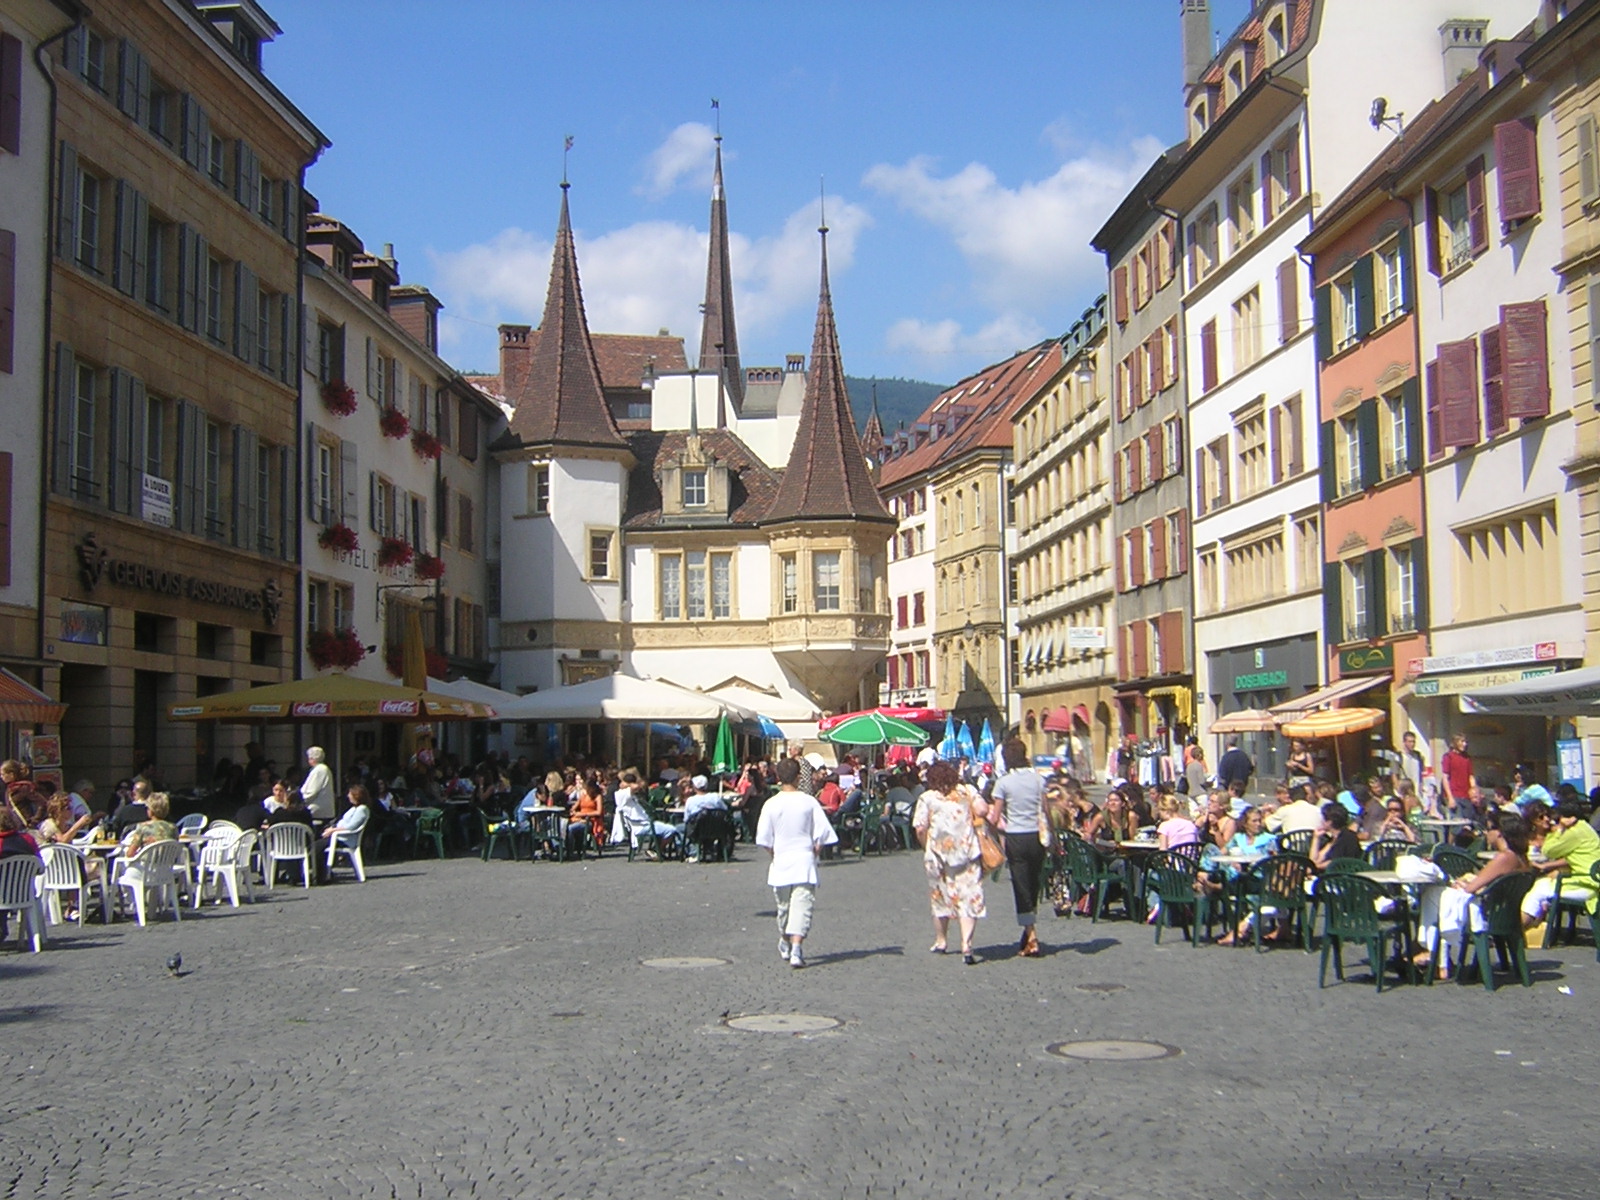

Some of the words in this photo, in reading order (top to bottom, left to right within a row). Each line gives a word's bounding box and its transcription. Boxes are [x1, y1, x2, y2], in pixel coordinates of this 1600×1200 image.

[144, 476, 149, 489] A
[150, 479, 169, 495] LOUER
[189, 578, 262, 611] ASSURANCES
[1235, 670, 1287, 690] DOSENBACH
[297, 702, 329, 714] Coca-Cola
[383, 700, 418, 713] Coca-Cola
